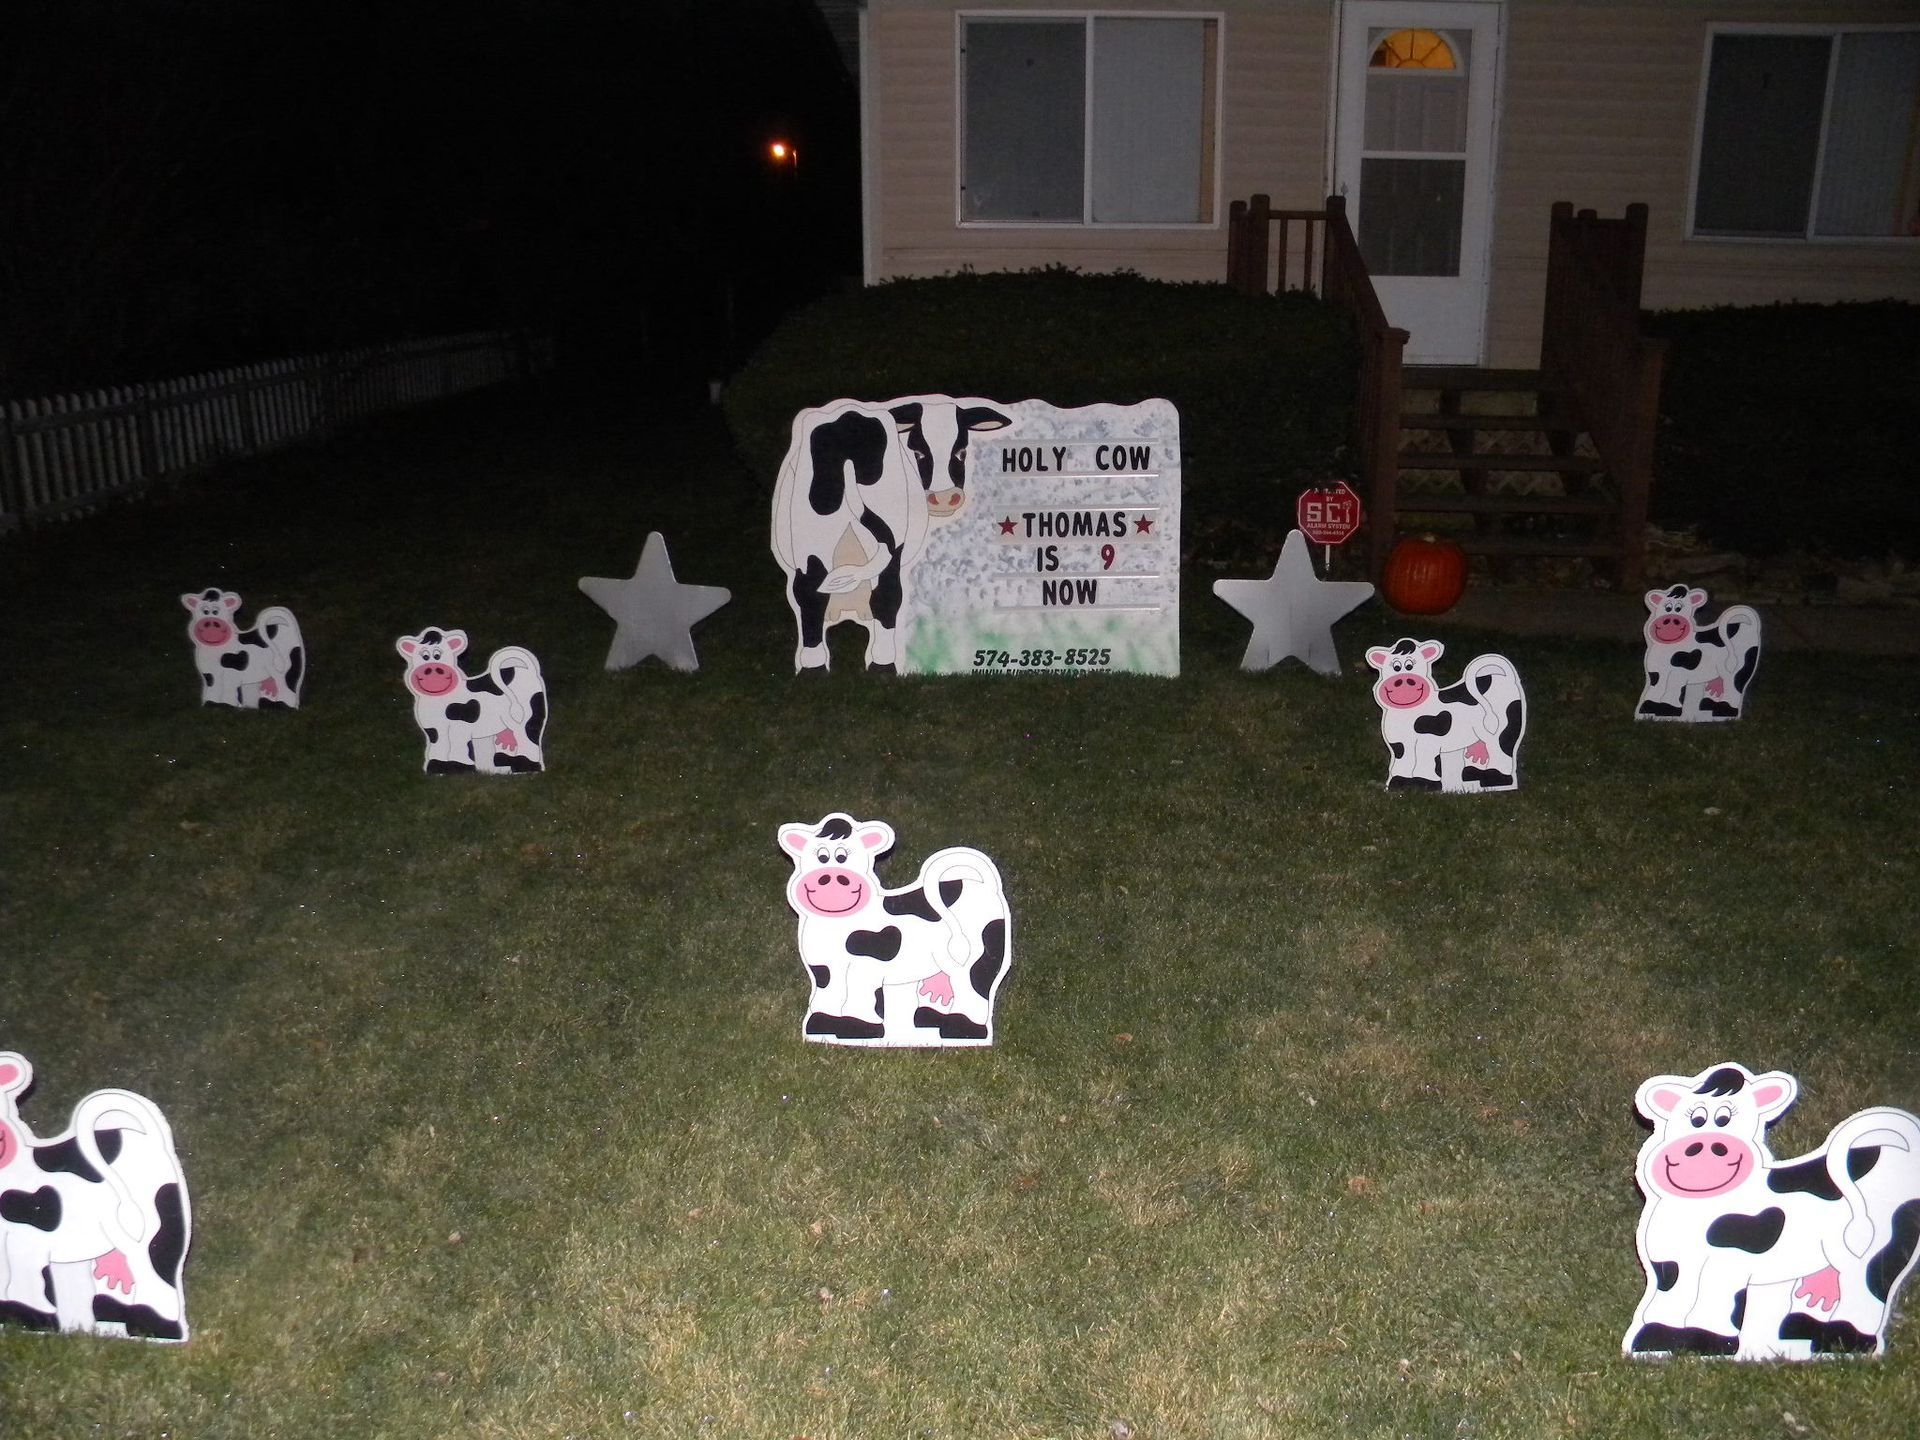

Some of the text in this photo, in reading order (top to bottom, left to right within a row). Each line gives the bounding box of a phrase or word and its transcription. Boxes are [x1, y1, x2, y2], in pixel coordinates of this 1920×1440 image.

[1002, 445, 1150, 472] HOLY COW
[1022, 511, 1127, 538] THOMAS
[1036, 544, 1115, 572] IS 9
[1042, 579, 1097, 606] NOW
[973, 648, 1112, 667] 574-383-8525
